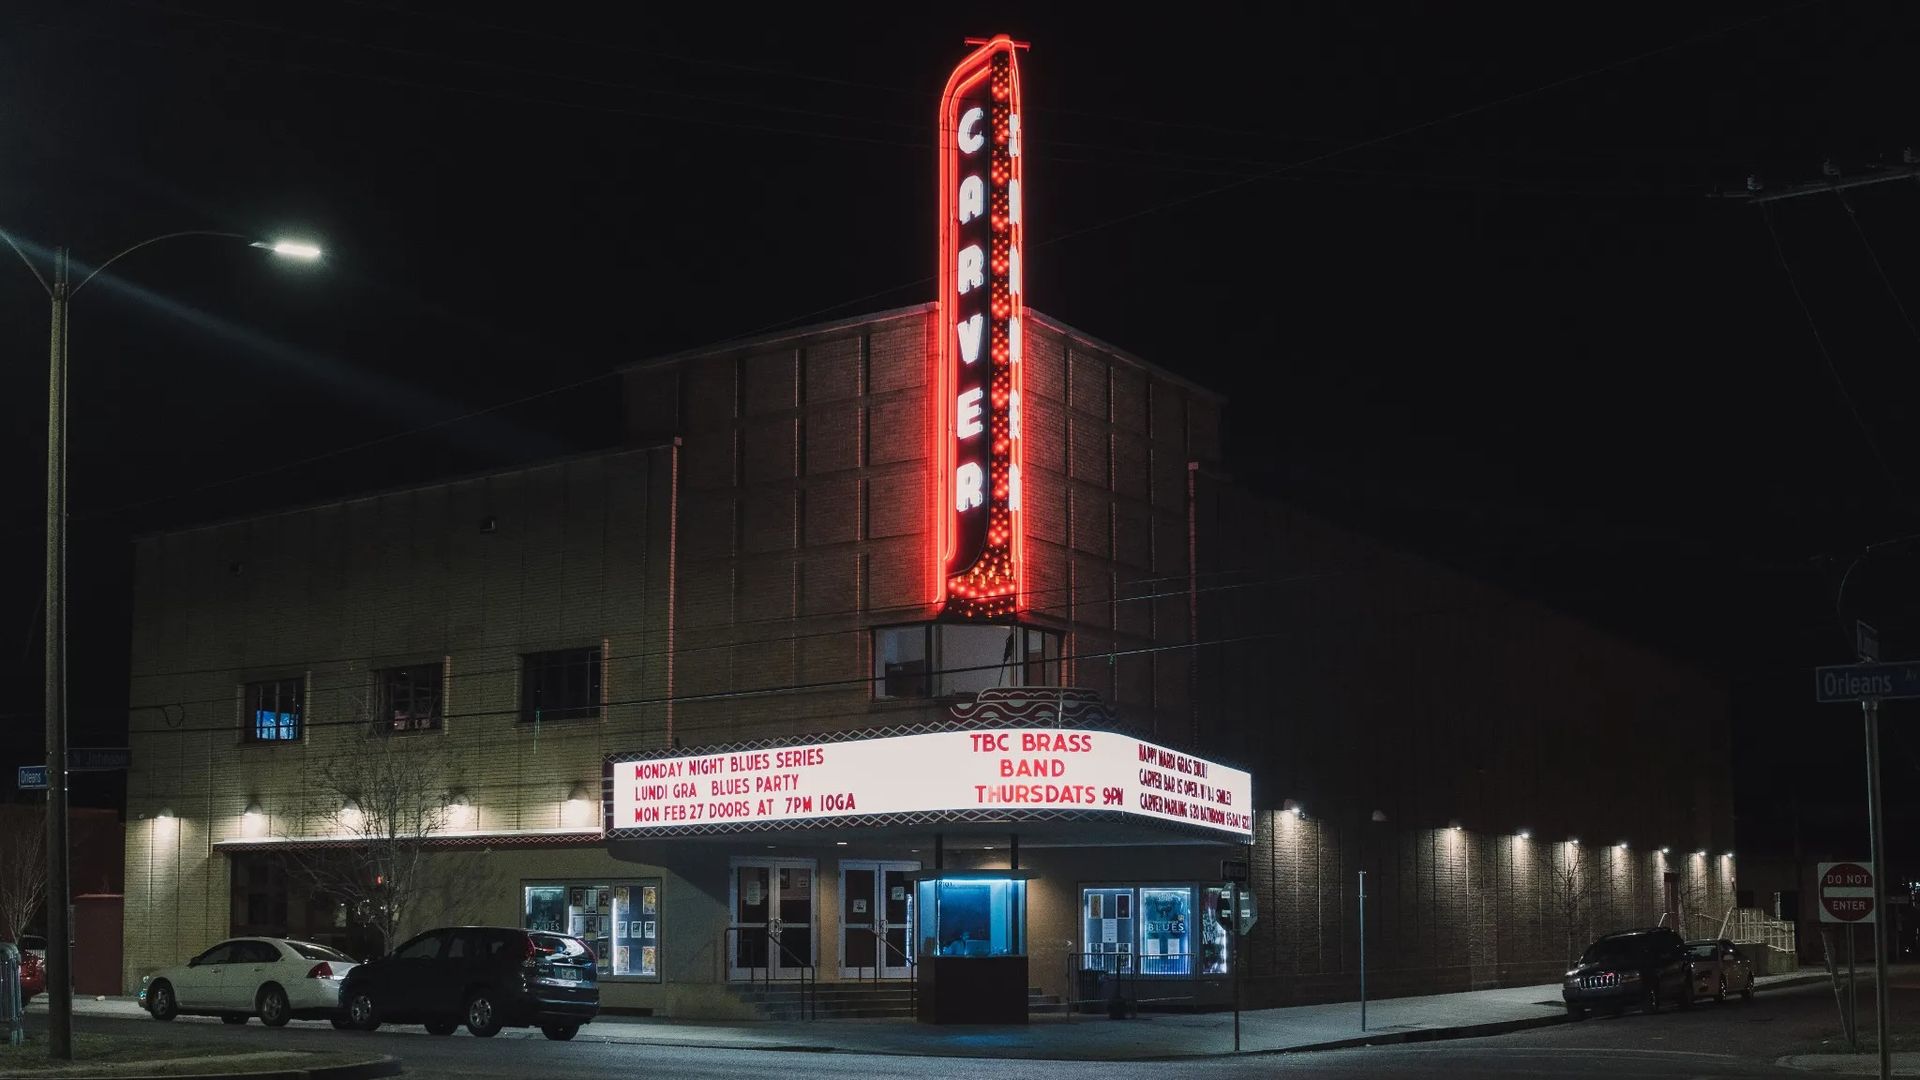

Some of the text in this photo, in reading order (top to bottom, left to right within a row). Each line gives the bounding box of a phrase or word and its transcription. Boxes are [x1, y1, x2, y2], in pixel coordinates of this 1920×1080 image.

[957, 107, 984, 512] CARVER
[1824, 672, 1893, 696] Orleans
[970, 733, 1092, 752] TBC BRASS
[635, 748, 824, 780] MONDAY NIGHT BLUES SERIES
[1000, 759, 1065, 777] BAND
[1139, 743, 1157, 765] HAPPY
[1158, 750, 1176, 770] MARDI
[1177, 755, 1192, 774] GRAS
[21, 770, 41, 784] Orleans
[635, 774, 799, 801] LUNDI GRA BLUES PARTY
[1139, 768, 1162, 789] CARVER
[1163, 774, 1176, 792] BAR
[1176, 778, 1183, 794] IS
[1103, 787, 1124, 806] 9PM
[1140, 792, 1163, 813] CARVER
[1164, 798, 1188, 818] PARKING
[635, 807, 660, 822] MON
[664, 805, 687, 821] FEB
[689, 804, 704, 820] 27
[709, 801, 750, 819] DOORS
[757, 799, 774, 816] AT
[785, 796, 812, 814] 7PM
[1827, 874, 1868, 884] DO NOT
[1832, 900, 1866, 911] ENTER
[1148, 923, 1185, 931] BLUES
